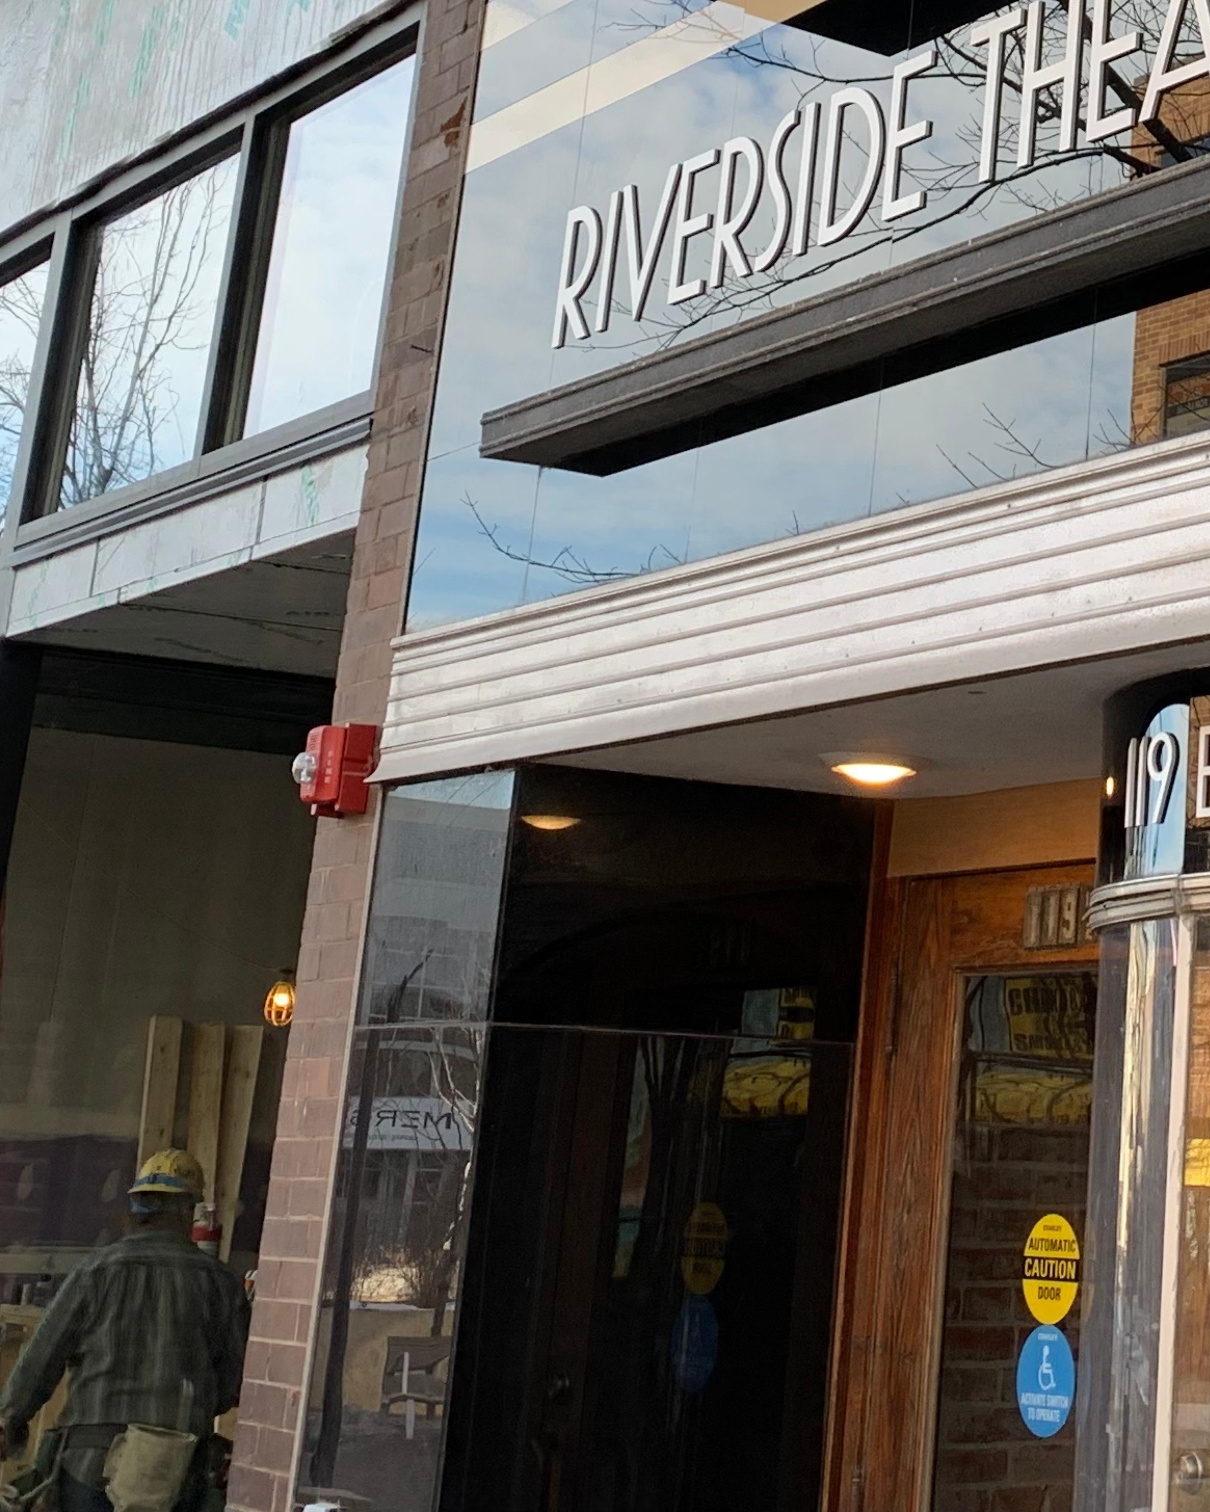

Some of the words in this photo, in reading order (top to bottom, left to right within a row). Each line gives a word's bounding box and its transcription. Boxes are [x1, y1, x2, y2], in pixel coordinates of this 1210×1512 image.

[550, 49, 940, 350] RIVERSIDE
[1123, 730, 1179, 829] 119
[1028, 1237, 1077, 1253] AUTOMATIC
[1024, 1257, 1077, 1280] CAUTION
[1037, 1285, 1062, 1302] DOOR
